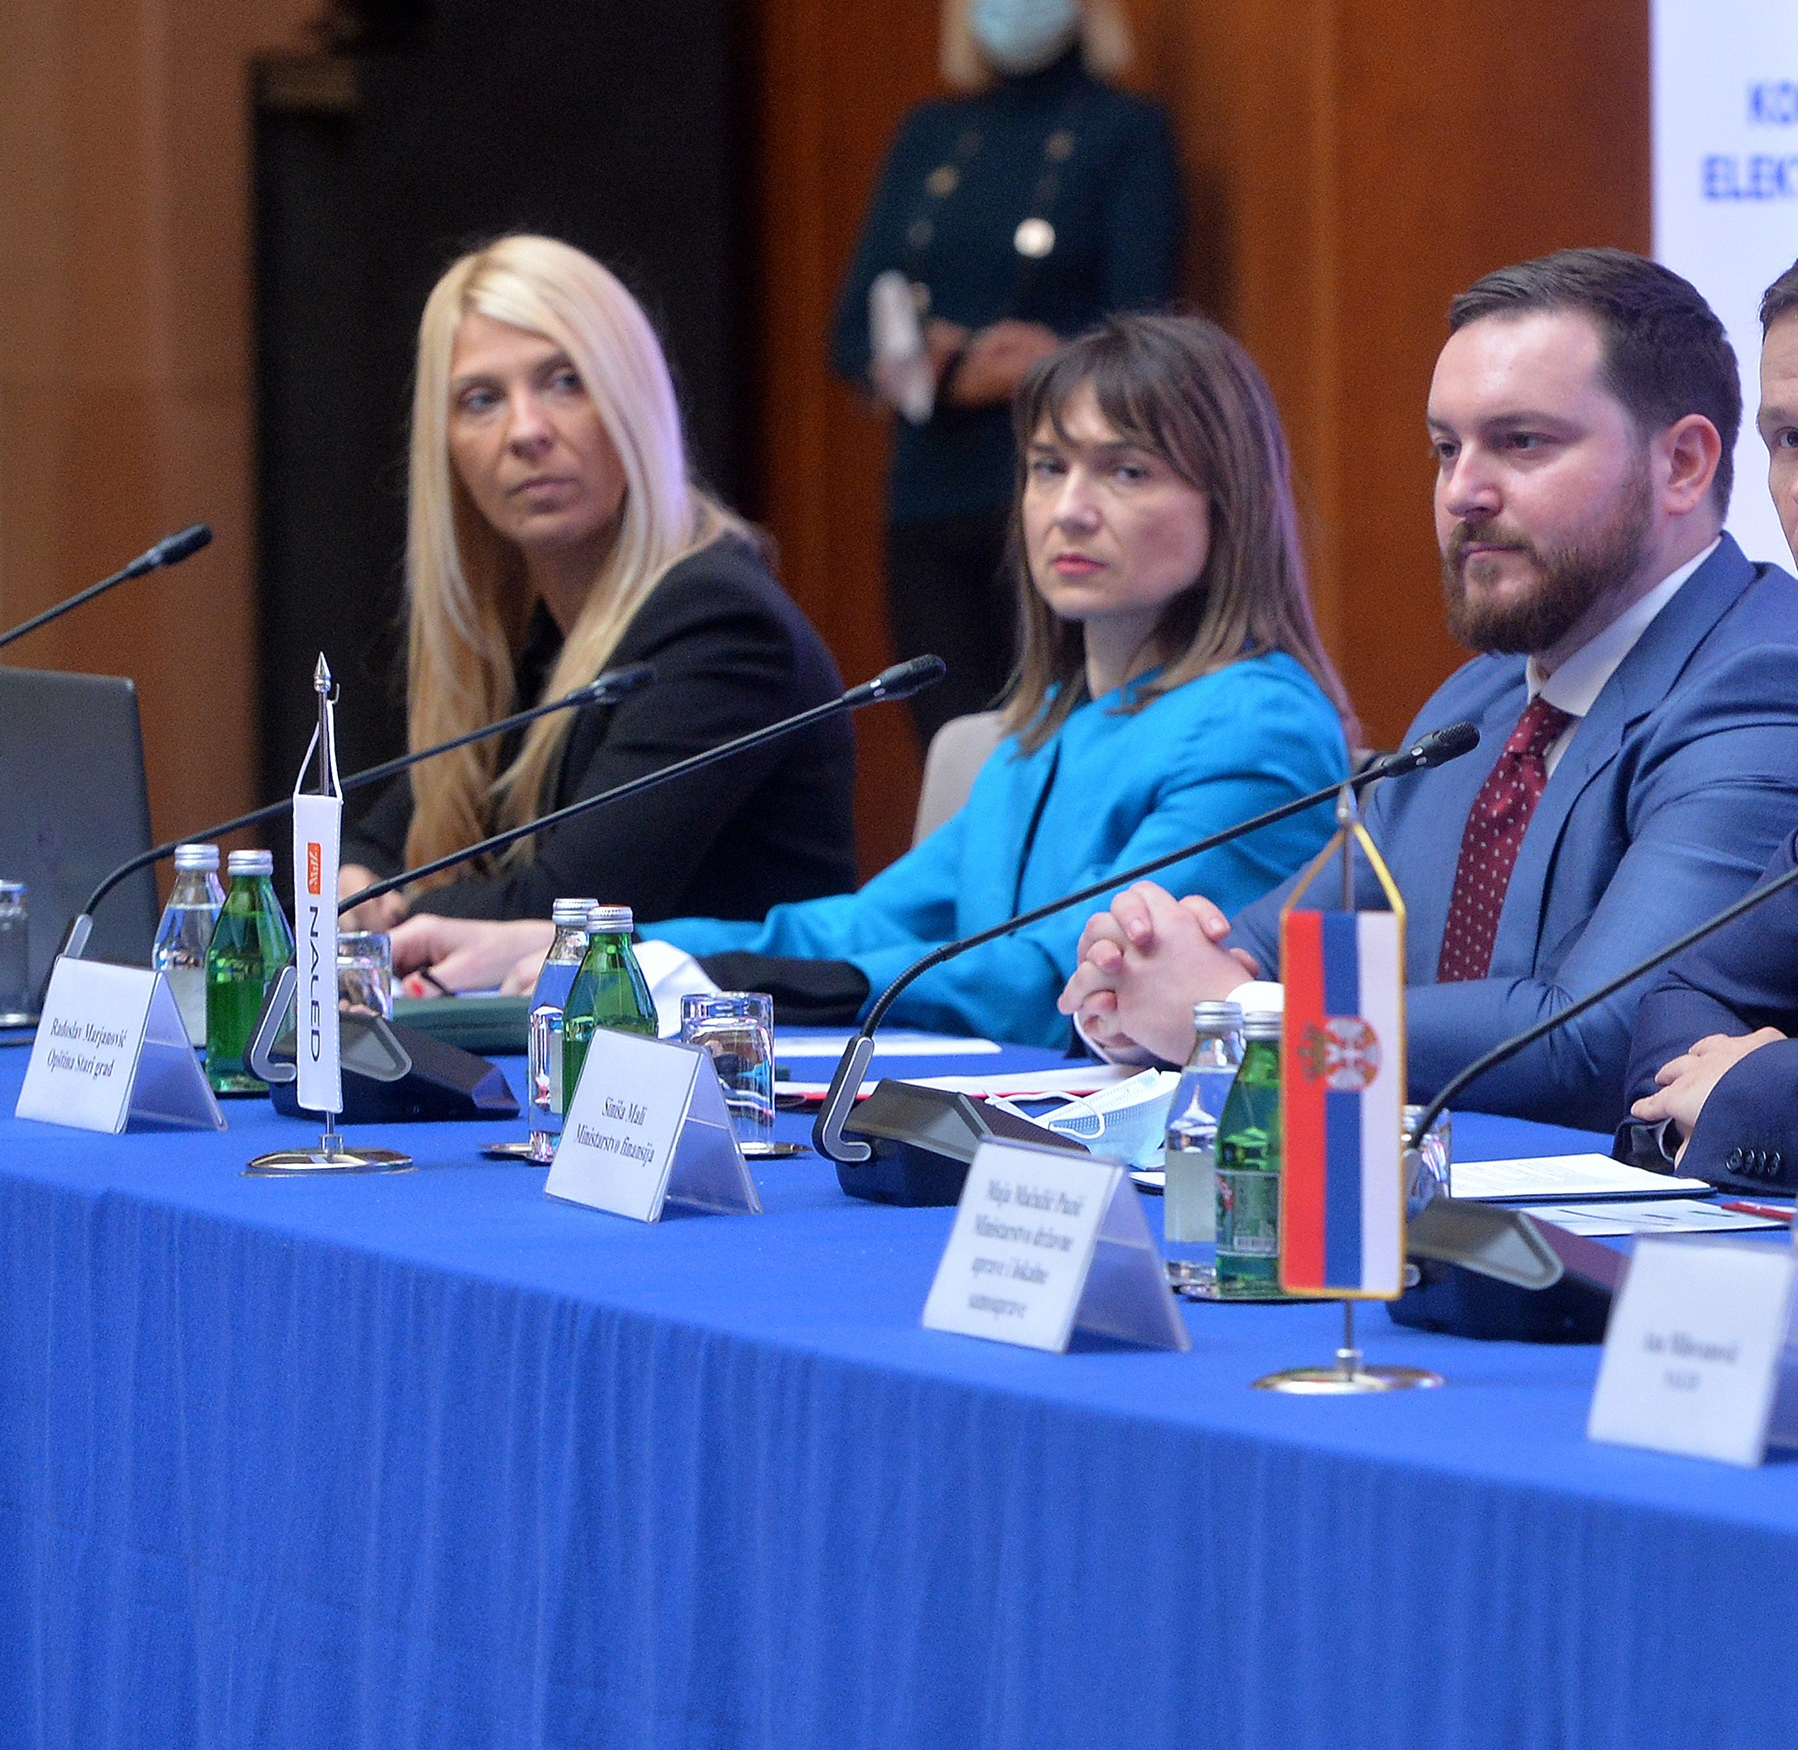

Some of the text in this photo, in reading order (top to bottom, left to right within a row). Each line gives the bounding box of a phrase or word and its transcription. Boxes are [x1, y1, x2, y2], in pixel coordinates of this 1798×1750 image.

[309, 906, 321, 1062] NALED
[50, 1018, 82, 1039] Radoslav
[75, 1054, 95, 1073] Stari
[94, 1059, 115, 1080] grad
[602, 1097, 647, 1125] Siniša Mali
[574, 1124, 655, 1167] Ministarstvo finansija
